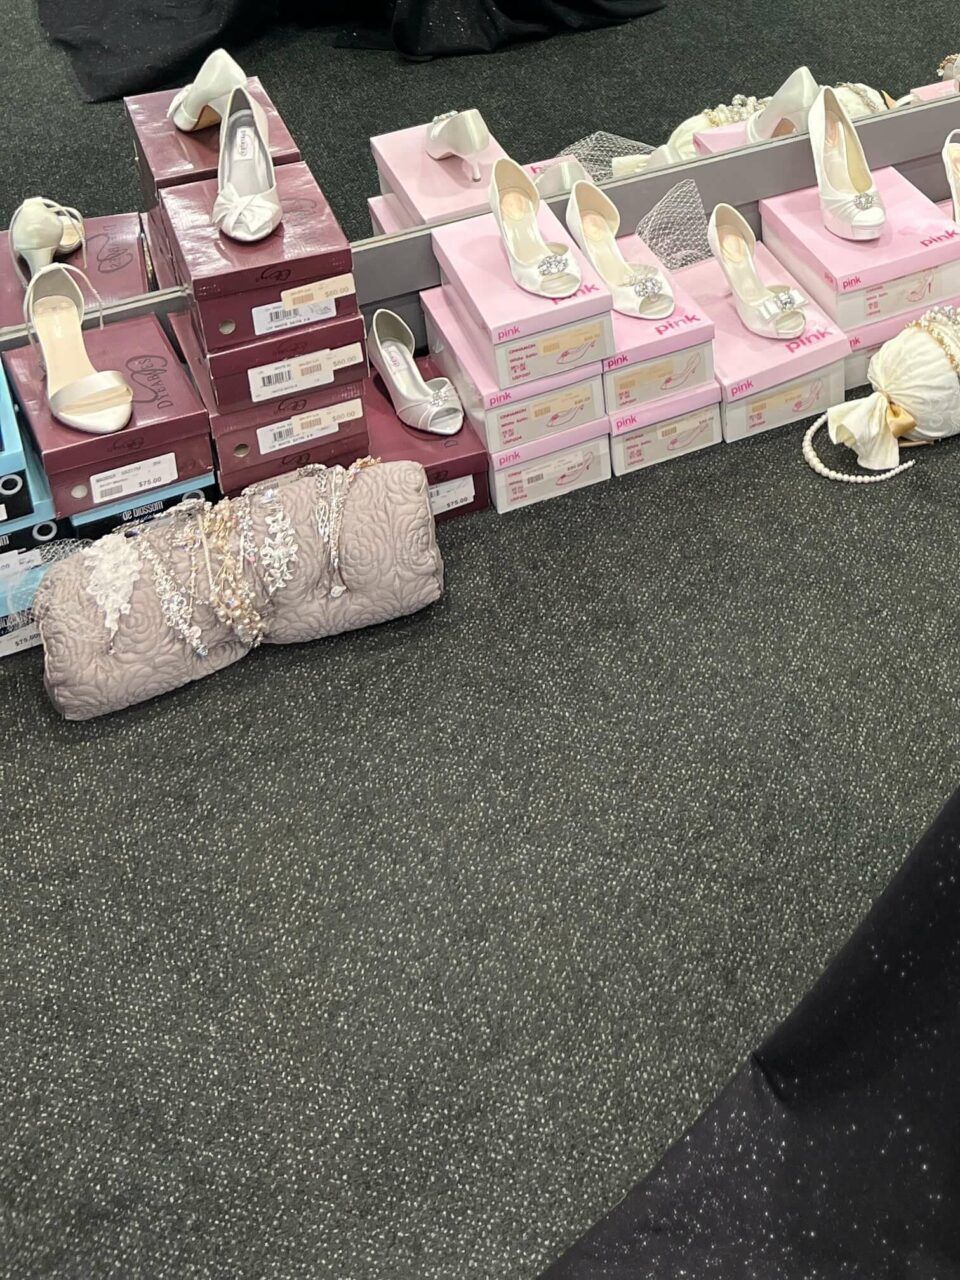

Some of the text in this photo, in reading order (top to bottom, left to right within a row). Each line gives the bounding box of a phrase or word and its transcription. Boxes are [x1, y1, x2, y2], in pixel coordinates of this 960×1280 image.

[919, 229, 960, 247] pink
[842, 276, 861, 290] pink
[655, 314, 701, 335] pink
[497, 326, 520, 340] pink
[785, 327, 833, 353] pink
[607, 354, 629, 369] pink
[731, 379, 754, 397] pink
[489, 392, 512, 406] pink
[616, 415, 637, 431] pink
[499, 451, 521, 465] pink
[138, 476, 162, 488] $75.00
[446, 496, 468, 508] $75.00
